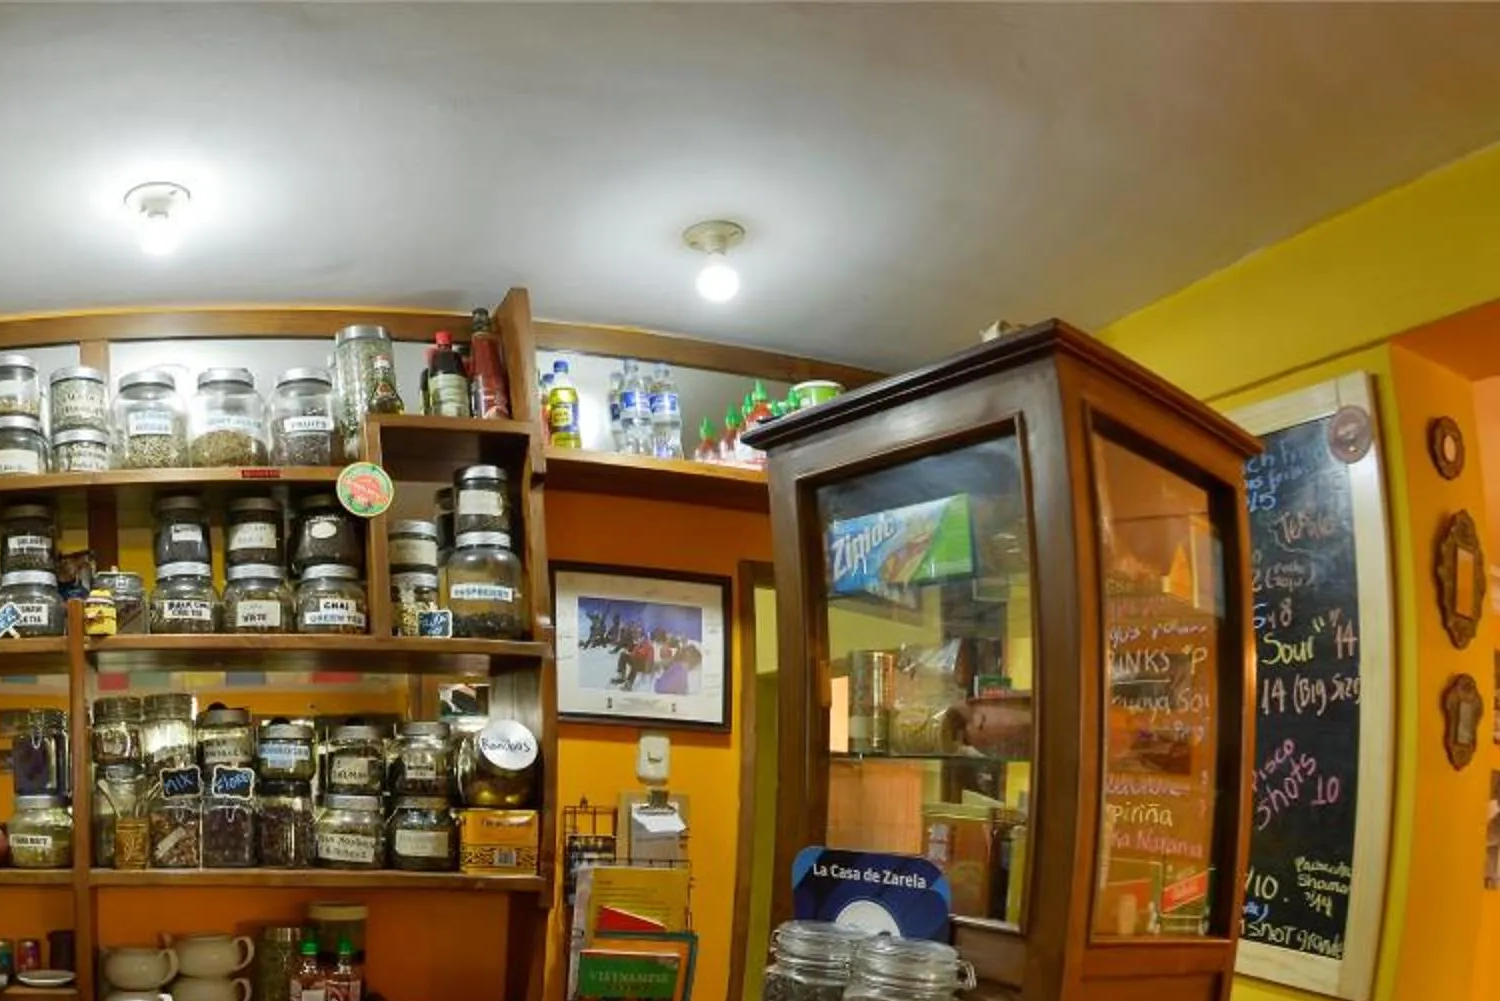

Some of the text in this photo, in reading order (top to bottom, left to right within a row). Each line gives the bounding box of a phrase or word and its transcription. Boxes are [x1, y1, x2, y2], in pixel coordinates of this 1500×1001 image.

[812, 862, 928, 890] La Casa de Zarela
